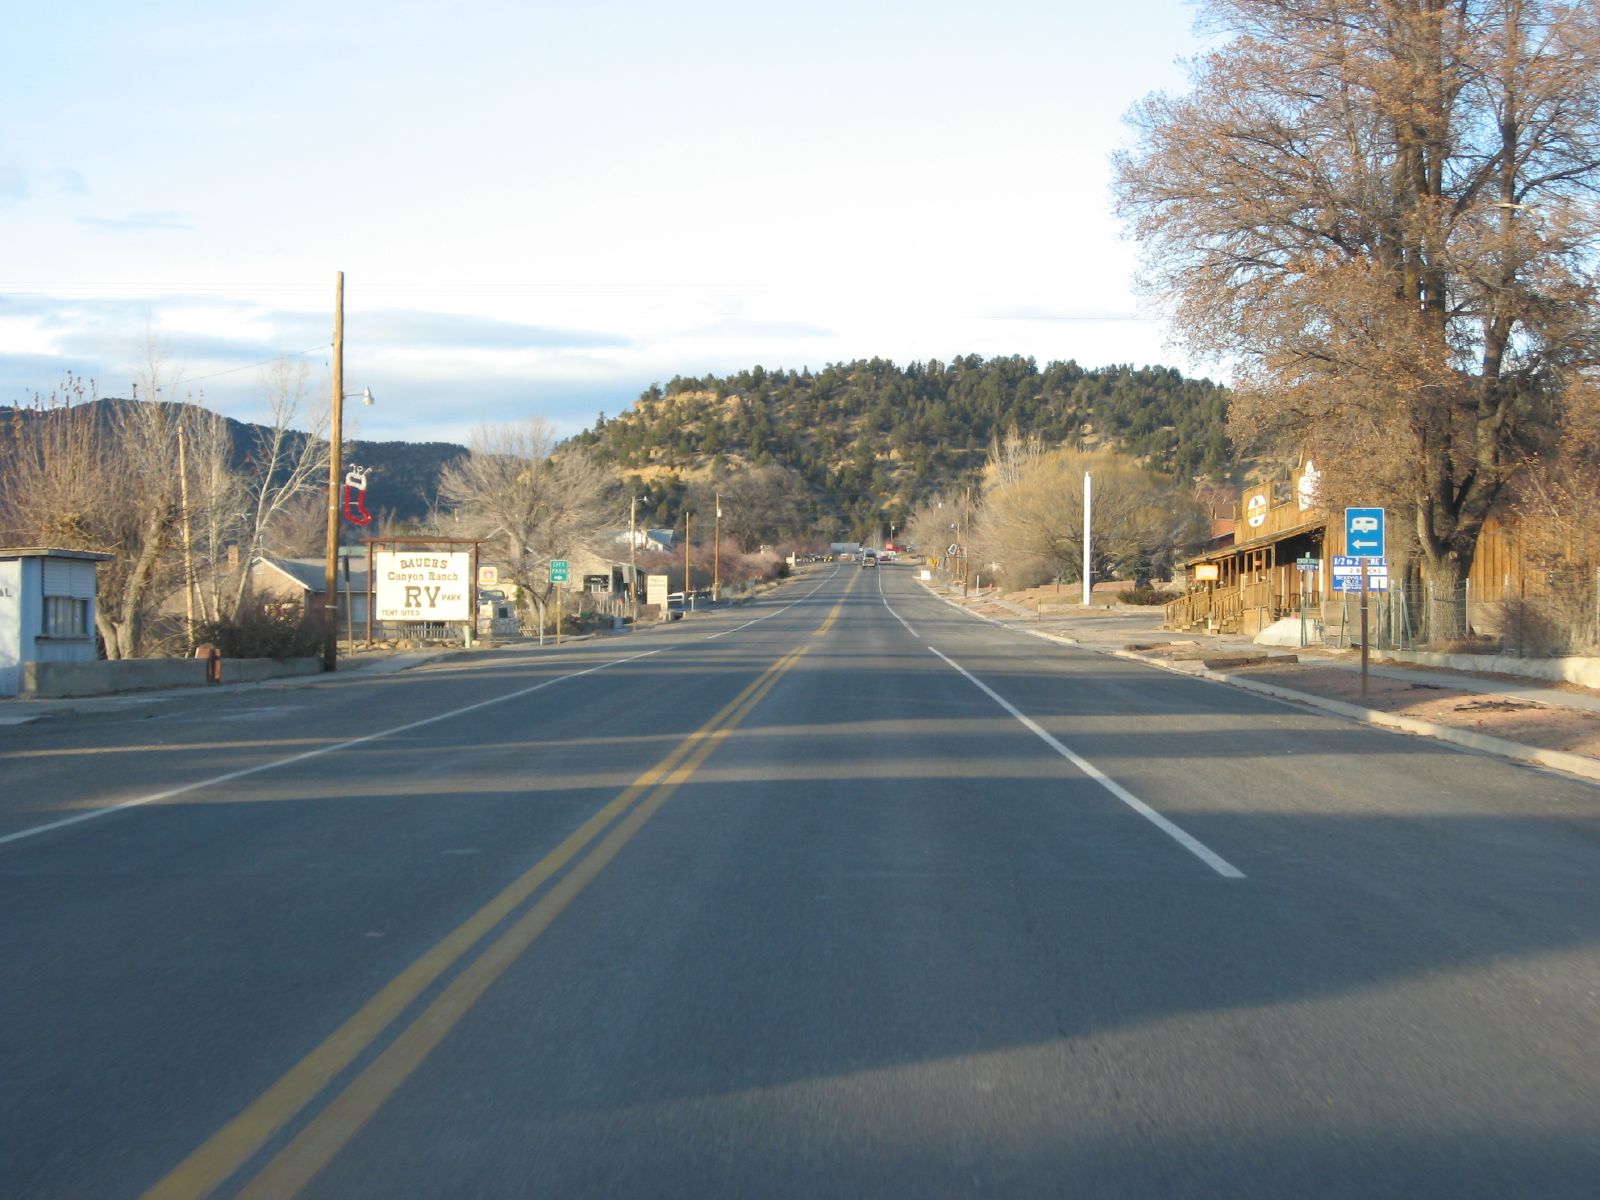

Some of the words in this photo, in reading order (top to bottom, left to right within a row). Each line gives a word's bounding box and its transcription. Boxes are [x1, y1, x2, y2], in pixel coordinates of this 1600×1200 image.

[400, 557, 448, 569] BAUERS
[1334, 557, 1345, 565] 1/2
[388, 571, 424, 582] Canyon
[428, 571, 458, 581] Ranch
[405, 586, 441, 607] RV
